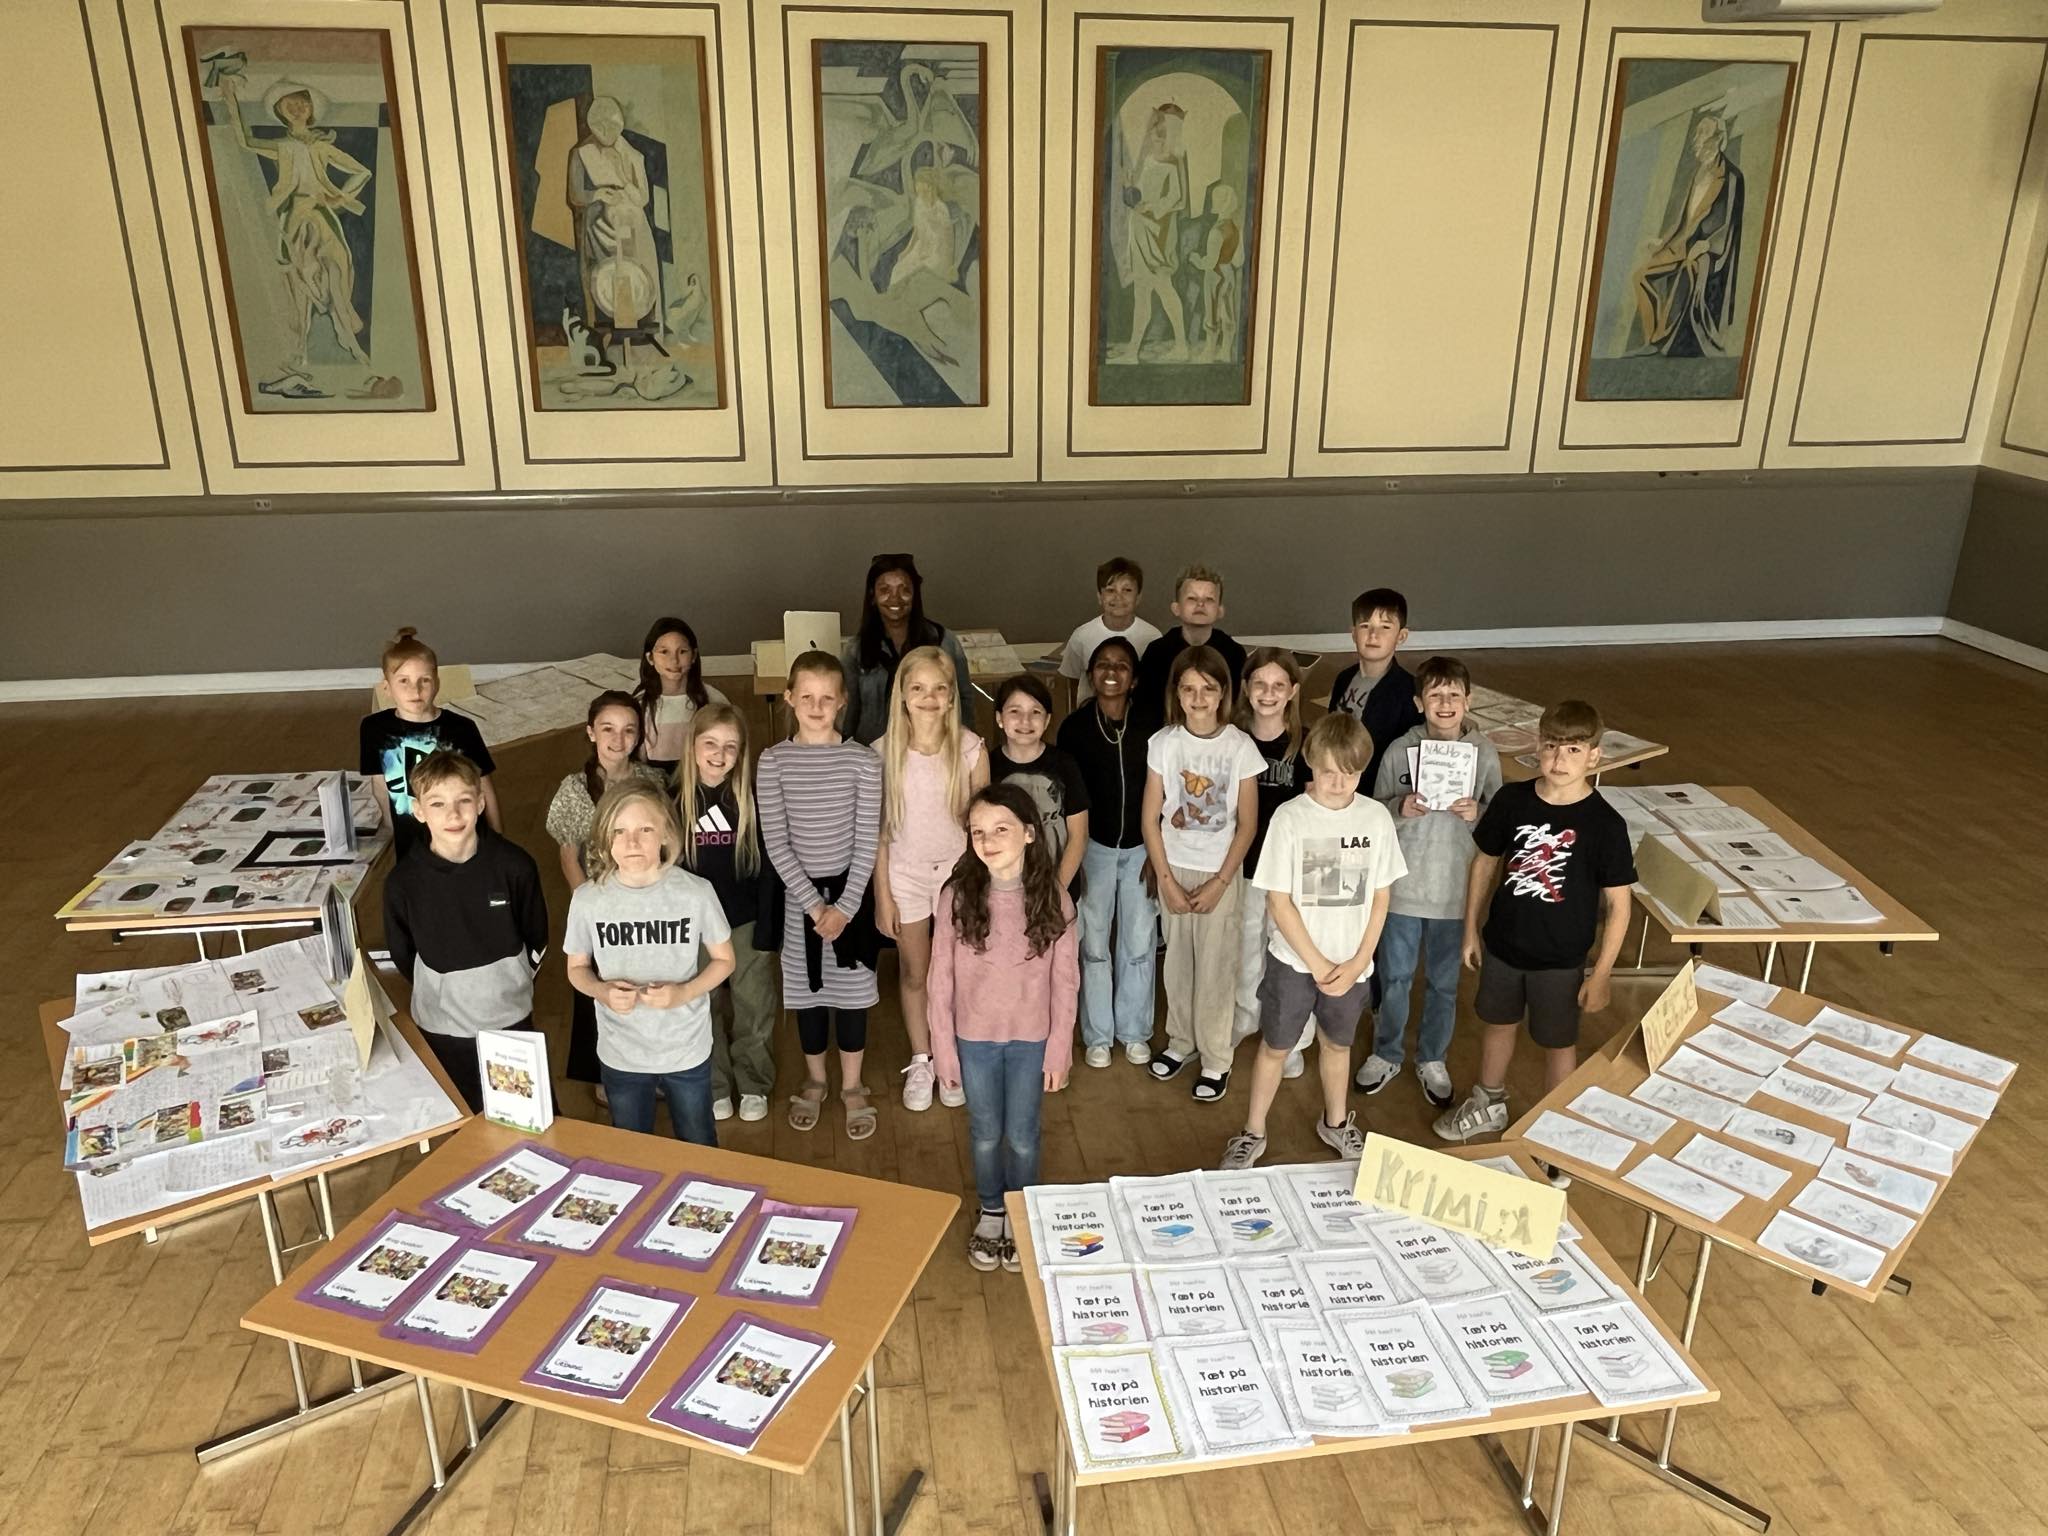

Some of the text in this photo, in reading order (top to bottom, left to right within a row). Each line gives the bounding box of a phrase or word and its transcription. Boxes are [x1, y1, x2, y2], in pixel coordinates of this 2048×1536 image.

[1340, 836, 1371, 849] LA&
[596, 917, 691, 948] FORTNITE
[1310, 1200, 1361, 1209] historien
[1141, 1212, 1193, 1223] historien
[1219, 1207, 1271, 1216] historien
[1052, 1222, 1104, 1231] historien
[1399, 1246, 1451, 1260] historien
[1329, 1293, 1385, 1304] historien
[1072, 1309, 1129, 1319] historien
[1168, 1304, 1225, 1314] historien
[1465, 1334, 1522, 1349] historien
[1578, 1335, 1636, 1349] historien
[1370, 1353, 1429, 1367] historien
[1198, 1382, 1259, 1397] historien
[1088, 1396, 1149, 1408] historien
